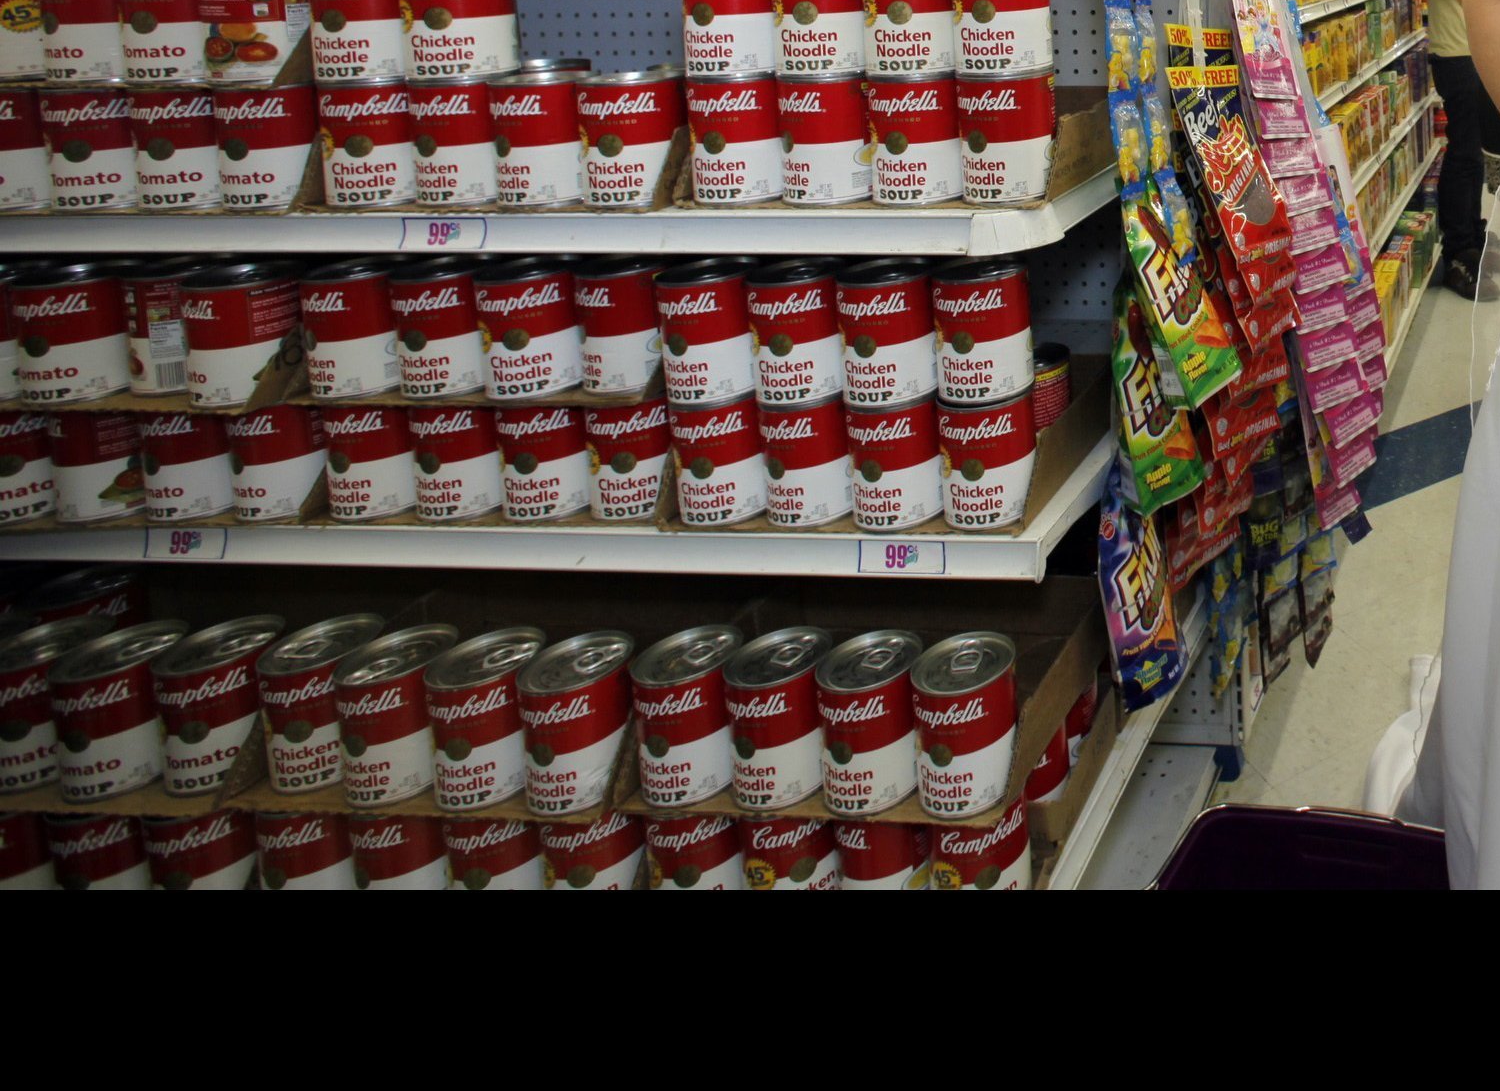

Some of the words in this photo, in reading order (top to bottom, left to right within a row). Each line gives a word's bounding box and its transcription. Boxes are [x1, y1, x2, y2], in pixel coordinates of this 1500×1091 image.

[686, 30, 734, 44] Chicken
[781, 28, 838, 42] Chicken
[874, 29, 932, 42] Chicken
[961, 28, 1015, 41] Chicken
[315, 36, 370, 50] Chicken
[411, 35, 475, 48] Chicken
[414, 49, 474, 62] Noodle
[688, 45, 733, 58] Noodle
[783, 43, 837, 56] Noodle
[876, 43, 930, 56] Noodle
[962, 42, 1014, 56] Noodle
[416, 63, 472, 76] SOUP
[689, 60, 730, 71] SOUP
[785, 59, 833, 71] SOUP
[879, 59, 928, 71] SOUP
[965, 58, 1011, 69] SOUP
[127, 67, 179, 79] SOUP
[318, 66, 366, 77] SOUP
[1171, 70, 1197, 86] 50%
[1205, 69, 1238, 85] FREE!
[1184, 90, 1219, 145] Beef
[331, 162, 397, 175] Chicken
[587, 162, 645, 175] Chicken
[695, 159, 746, 172] Chicken
[876, 158, 927, 172] Chicken
[334, 175, 396, 189] Noodle
[589, 175, 644, 188] Noodle
[878, 173, 927, 186] Noodle
[58, 193, 115, 207] SOUP
[337, 190, 393, 202] SOUP
[591, 190, 641, 203] SOUP
[698, 188, 742, 199] SOUP
[879, 188, 926, 201] SOUP
[427, 223, 450, 245] 99
[490, 351, 552, 369] Chicken
[758, 358, 814, 374] Chicken
[942, 356, 994, 371] Chicken
[493, 365, 552, 382] Noodle
[845, 360, 896, 374] Chicken
[761, 373, 814, 388] Noodle
[846, 375, 896, 389] Noodle
[943, 371, 993, 385] Noodle
[497, 379, 550, 395] SOUP
[946, 386, 991, 399] SOUP
[763, 388, 811, 400] SOUP
[849, 391, 893, 403] SOUP
[939, 413, 1016, 445] Campbell's
[599, 474, 658, 491] Chicken
[600, 487, 658, 505] Noodle
[950, 483, 1004, 498] Chicken
[951, 498, 1004, 511] Noodle
[954, 512, 1001, 525] SOUP
[170, 530, 192, 555] 99
[885, 544, 907, 569] 99
[273, 740, 340, 762] Chicken
[278, 768, 336, 787] SOUP
